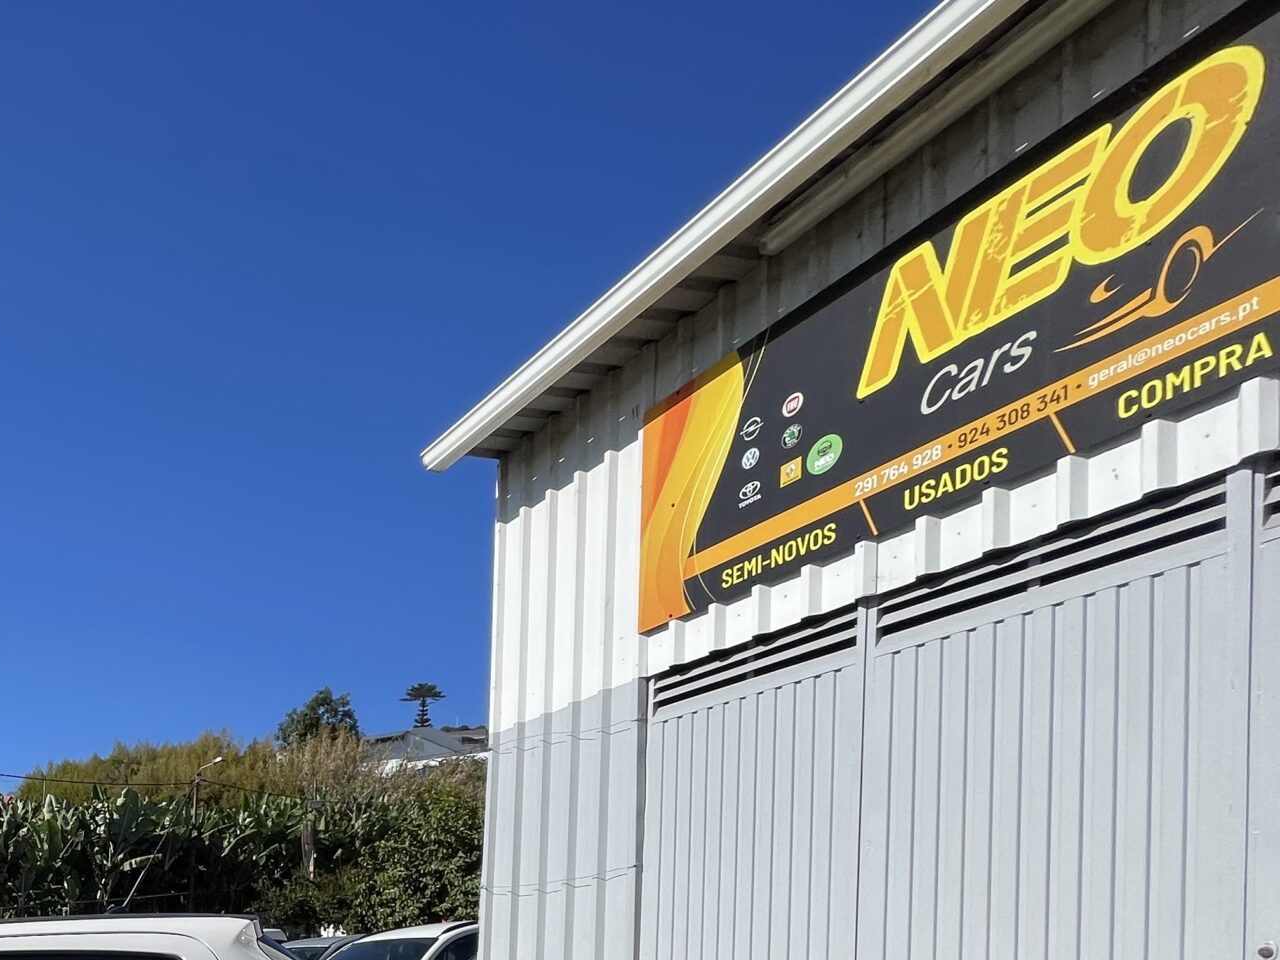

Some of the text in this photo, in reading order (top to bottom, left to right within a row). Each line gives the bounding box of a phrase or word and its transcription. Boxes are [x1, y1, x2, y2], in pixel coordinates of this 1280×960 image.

[856, 44, 1266, 399] NEO
[854, 296, 1260, 497] 291 764 928 924 308 341 geral@neocars.pt
[920, 330, 1038, 415] Cars
[1117, 331, 1274, 419] COMPRA
[738, 493, 762, 509] TOYOTA
[903, 447, 1009, 511] USADOS
[721, 522, 837, 589] SEMI-NOVOS
